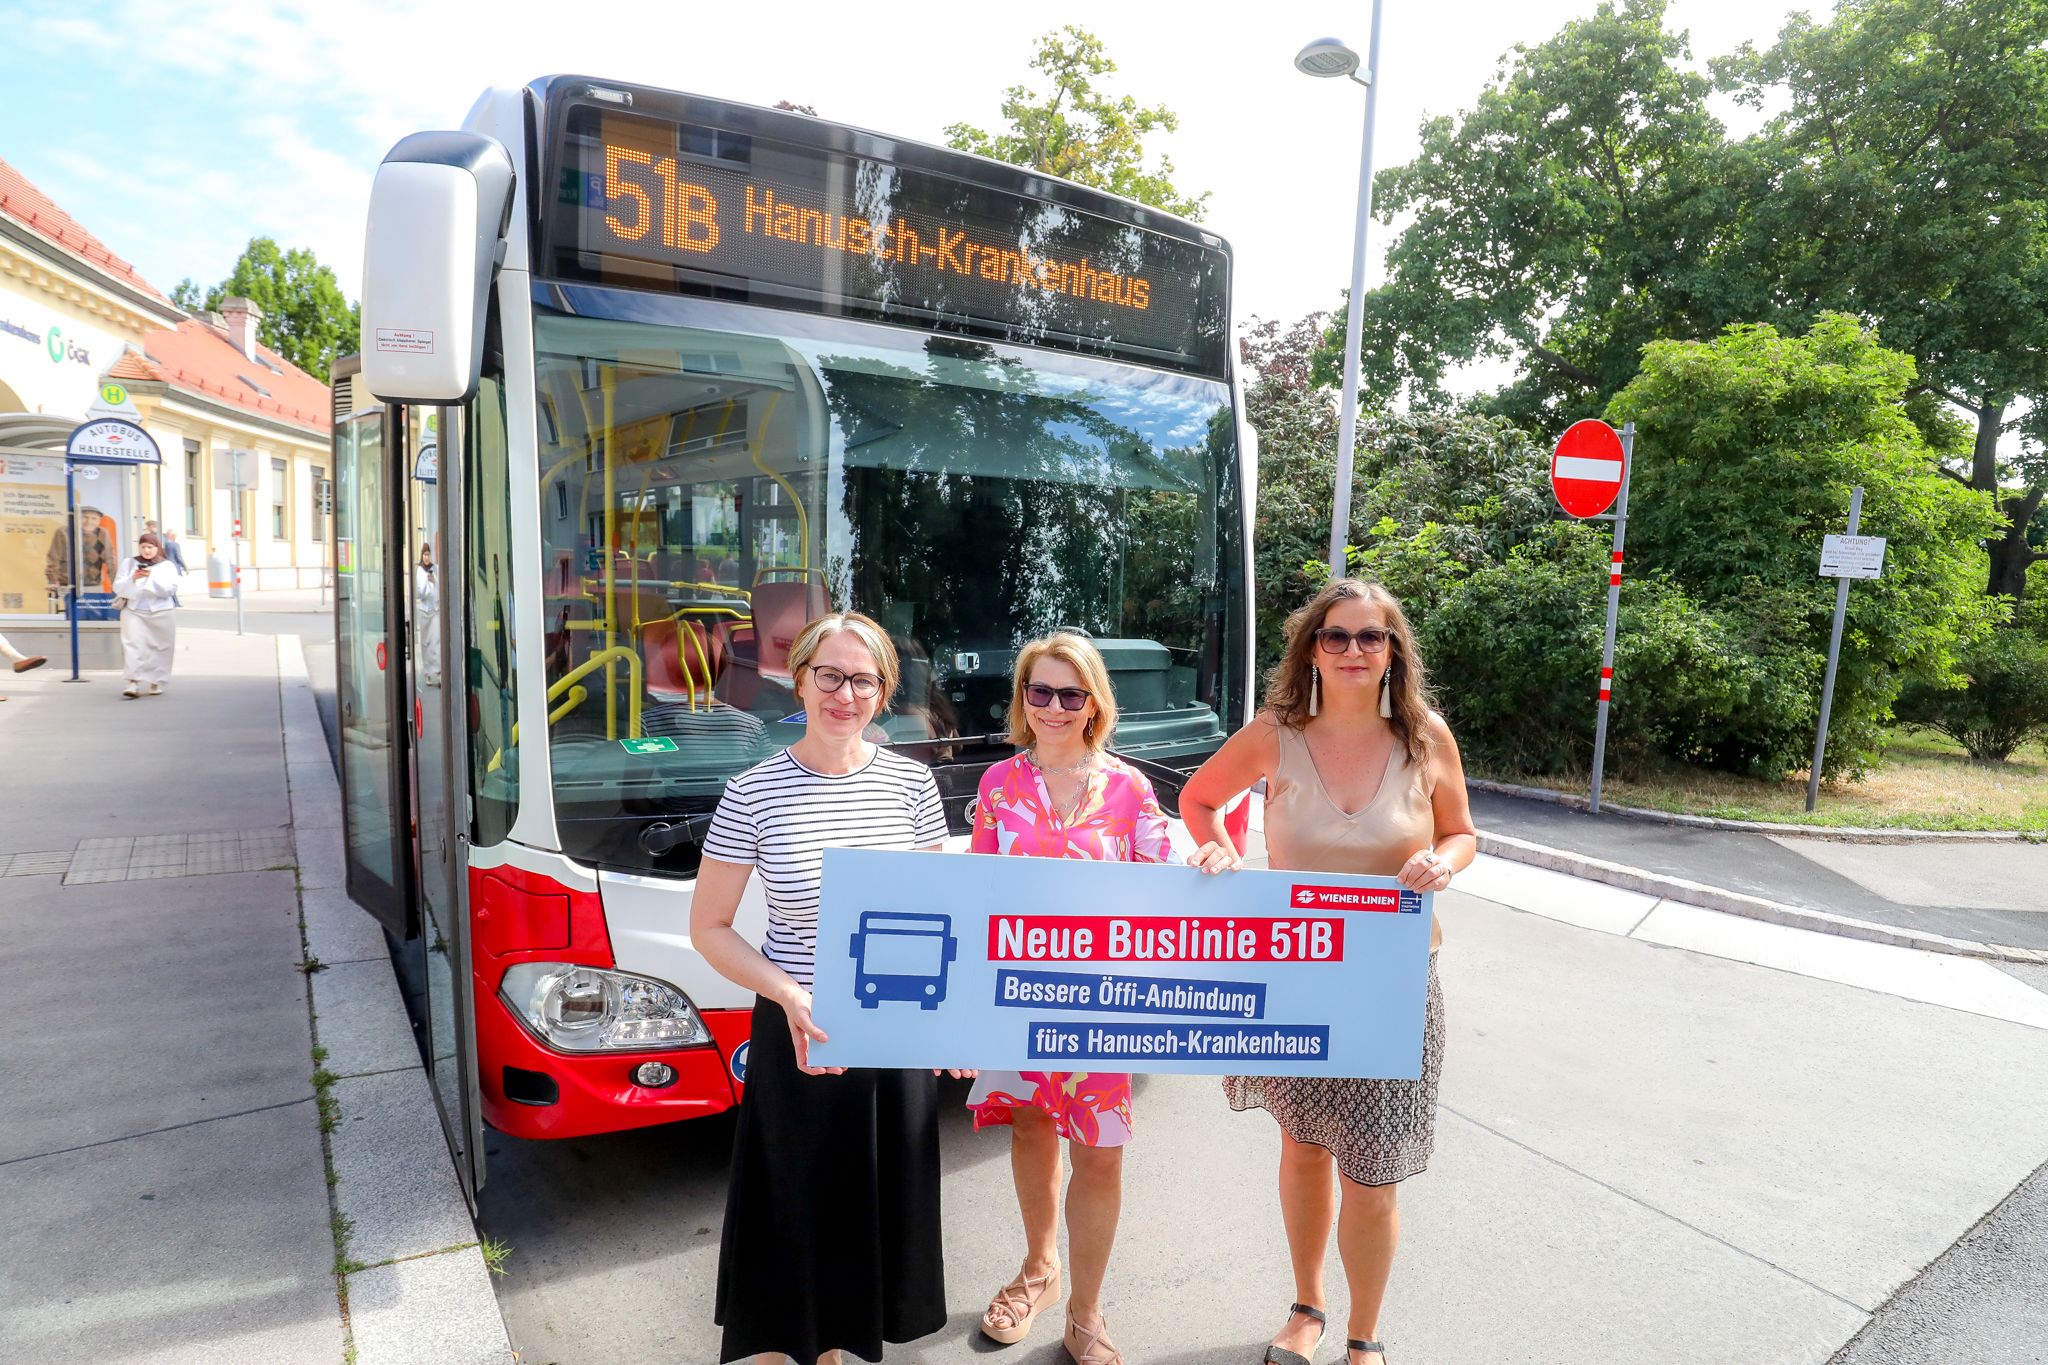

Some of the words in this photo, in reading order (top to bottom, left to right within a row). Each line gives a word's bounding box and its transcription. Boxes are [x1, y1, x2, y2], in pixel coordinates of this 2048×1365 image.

[606, 144, 720, 254] 51B
[745, 183, 1151, 311] Hanusch-Krankenhaus
[89, 424, 142, 442] AUTOBUS
[79, 444, 150, 458] HALTESTELLE
[1840, 537, 1871, 546] ACHTUNG!
[1319, 893, 1360, 904] WIENER
[1361, 895, 1395, 905] LINIEN
[998, 919, 1093, 959] Neue
[1108, 920, 1256, 959] Buslinie
[1270, 921, 1333, 960] 51B
[1004, 977, 1090, 1004] Bessere
[1099, 976, 1256, 1018] Öffi-Anbindung
[1036, 1028, 1079, 1053] fürs
[1088, 1029, 1321, 1055] Hanusch-Krankenhaus
